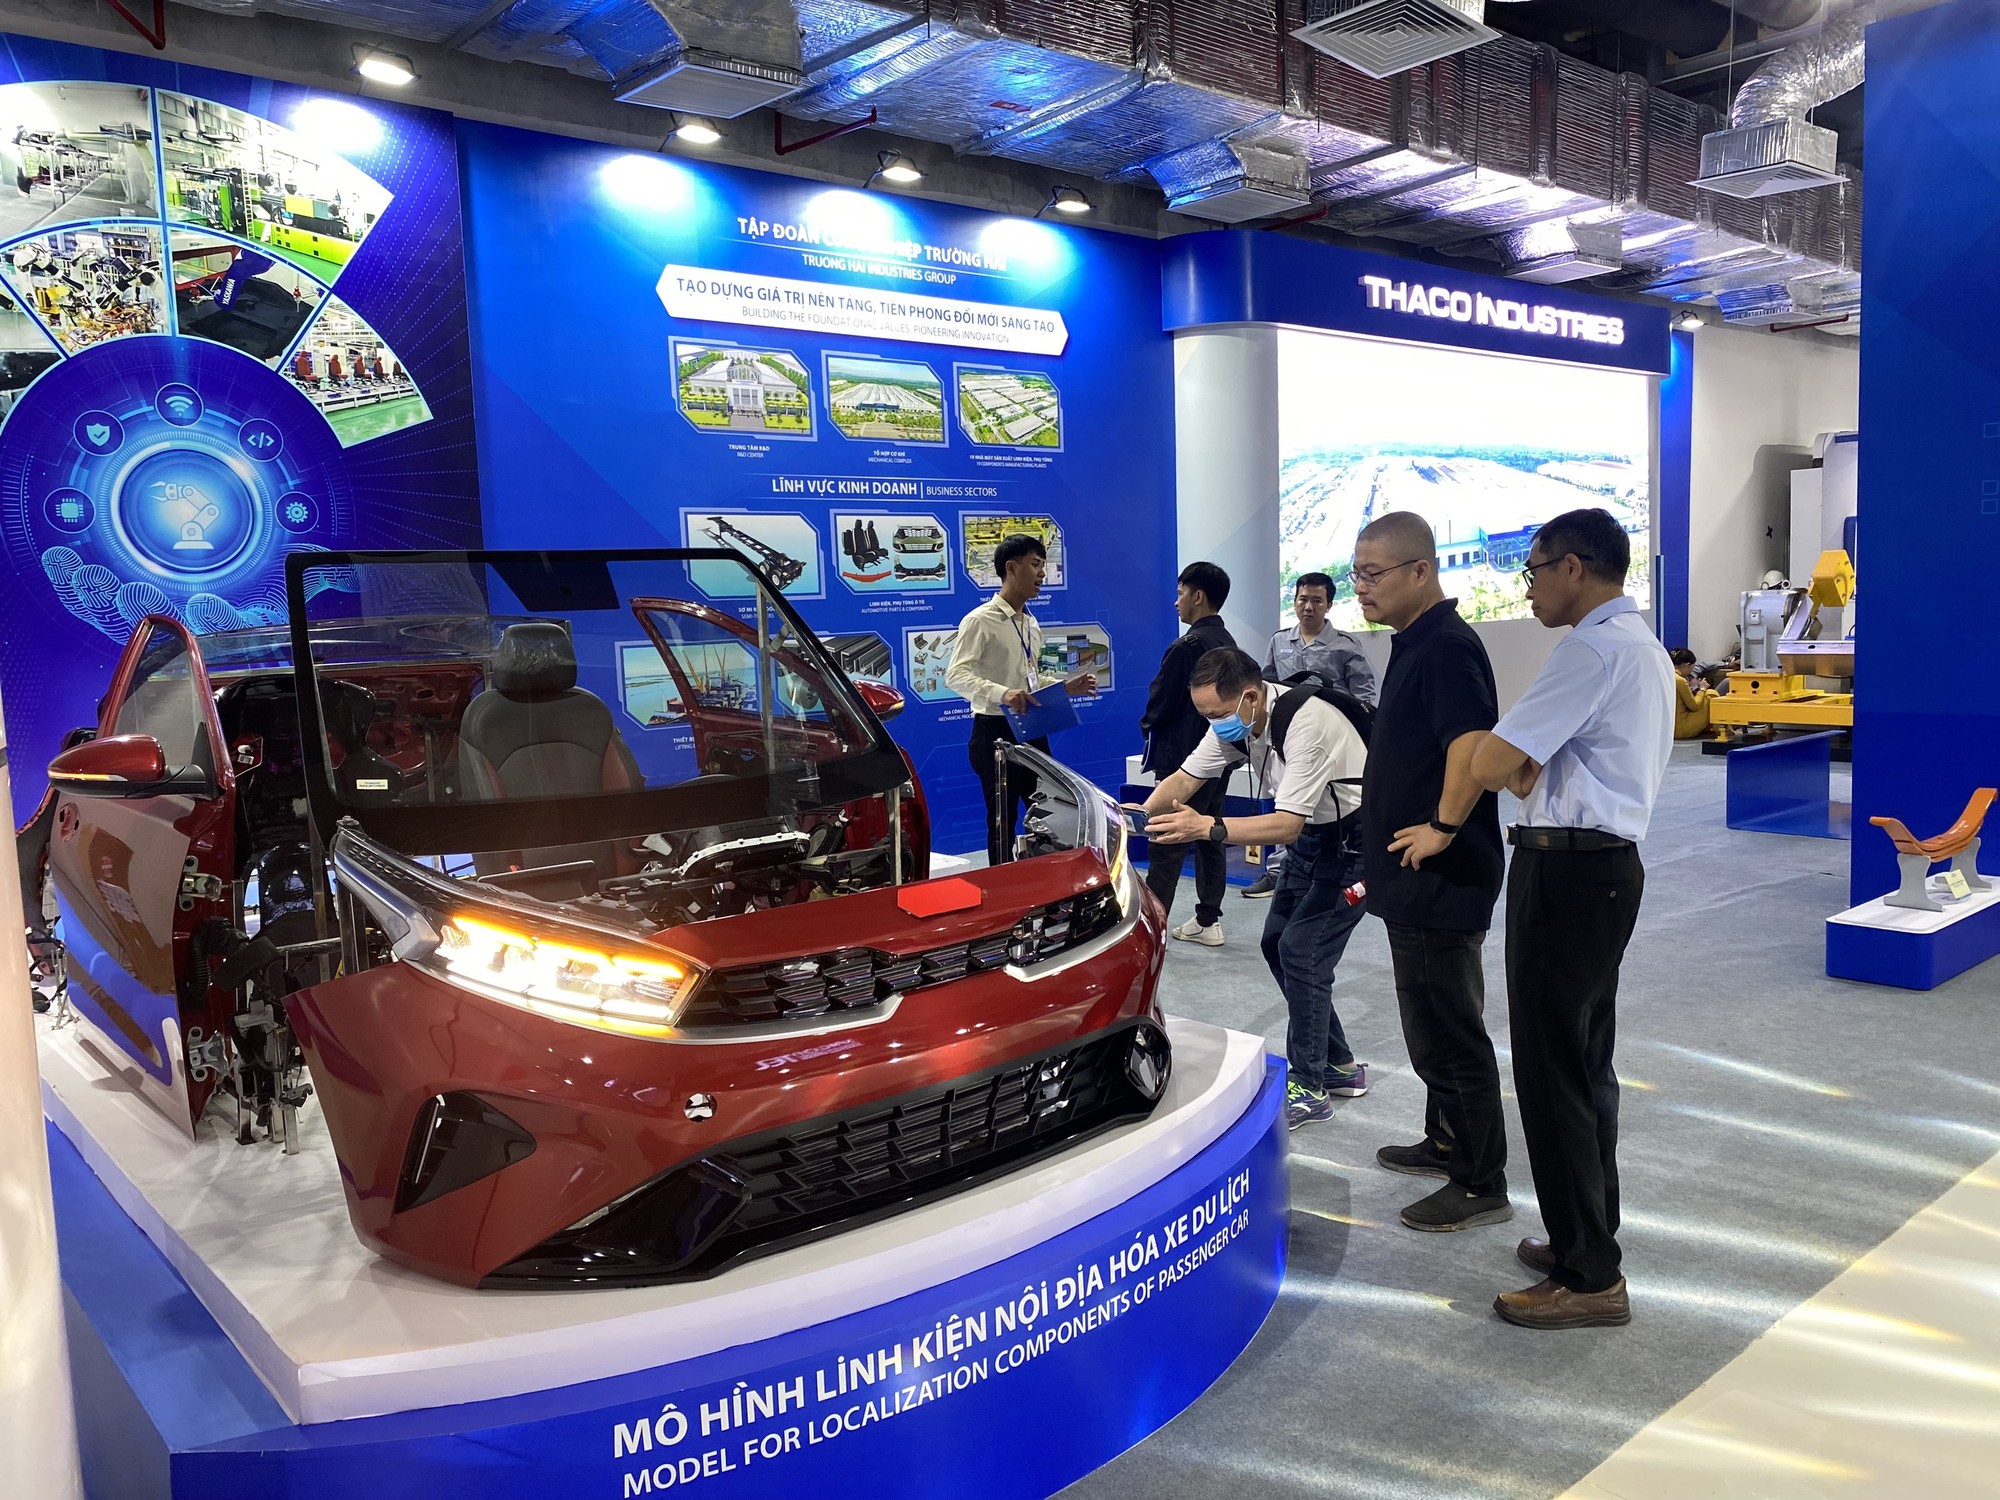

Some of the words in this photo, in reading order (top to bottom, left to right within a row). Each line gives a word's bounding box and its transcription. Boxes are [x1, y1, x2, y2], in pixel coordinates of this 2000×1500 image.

[737, 216, 770, 240] TẬP
[924, 246, 981, 268] TRƯỜNG
[802, 254, 846, 271] TRUONG
[848, 260, 866, 273] HAI
[868, 262, 923, 281] INDUSTRIES
[924, 271, 957, 285] GROUP
[676, 278, 707, 296] TẠO
[711, 282, 754, 301] DỰNG
[758, 286, 781, 302] GIÁ
[784, 290, 805, 309] TRỊ
[909, 306, 952, 322] PHONG
[1033, 320, 1055, 335] TẠO
[742, 306, 787, 321] BUILDING
[789, 311, 806, 322] THE
[913, 324, 961, 340] PIONEERING
[962, 329, 1010, 344] INNOVATION
[1360, 274, 1472, 322] THACO
[1472, 291, 1625, 346] INDUSTRIES
[772, 476, 804, 494] LĨNH
[806, 478, 836, 496] VỰC
[838, 481, 869, 494] KINH
[872, 482, 917, 495] DOANH
[926, 486, 963, 497] BUSINESS
[964, 487, 998, 498] SECTORS
[613, 1402, 689, 1459] MÔ
[1108, 1231, 1160, 1284] HÓA
[1163, 1214, 1189, 1254] XE
[1192, 1194, 1217, 1236] DU
[623, 1447, 737, 1499] MODEL
[743, 1426, 802, 1466] FOR
[808, 1357, 989, 1445] LOCALIZATION
[994, 1290, 1131, 1374] COMPONENTS
[1133, 1276, 1155, 1305] OF
[1158, 1227, 1229, 1292] PASSENGER
[1230, 1208, 1250, 1238] CAR
